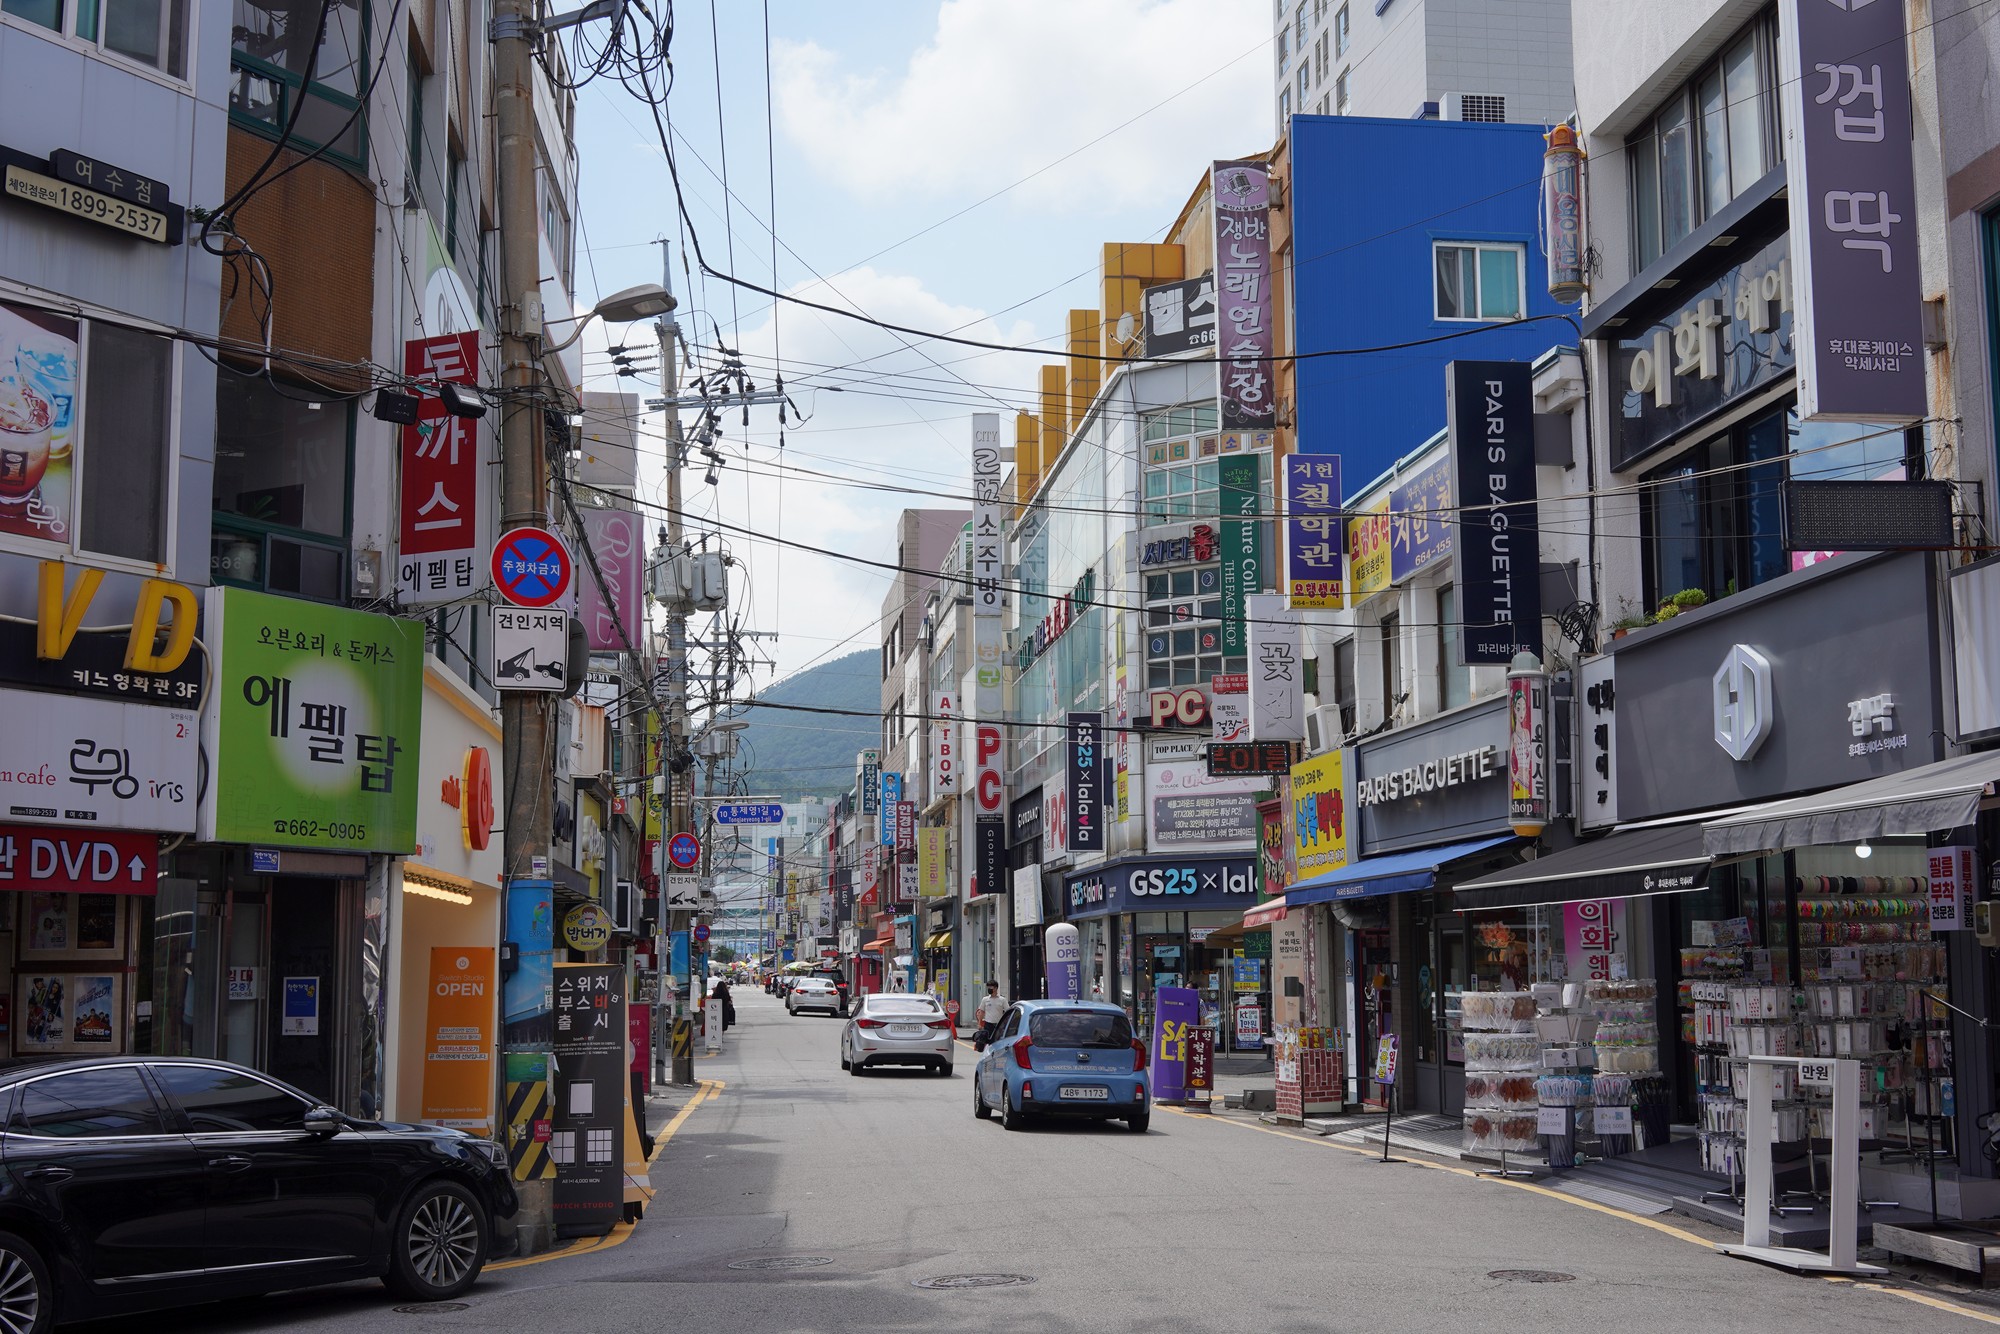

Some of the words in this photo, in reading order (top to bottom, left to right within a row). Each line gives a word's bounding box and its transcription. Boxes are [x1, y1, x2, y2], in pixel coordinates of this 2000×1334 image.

[60, 187, 163, 236] 1899-2537
[1220, 216, 1267, 241] 쟁반
[1225, 244, 1267, 402] 노래연습장
[1829, 339, 1913, 356] 휴대폰케이스
[1844, 356, 1901, 372] 악세사리
[1485, 380, 1506, 463] PARIS
[414, 342, 469, 532] 돈까스
[1293, 462, 1333, 478] 지헌
[1241, 496, 1255, 554] Nature
[1296, 483, 1338, 568] 철학관
[1391, 495, 1429, 554] 지헌
[1489, 474, 1512, 626] BAGUETTE
[402, 556, 474, 592] 에펠탑
[502, 559, 561, 578] 주정차금지
[497, 612, 564, 632] 견인지역
[257, 626, 325, 657] 오븐요리
[333, 644, 342, 656] &
[347, 635, 395, 664] 돈까스
[73, 670, 170, 695] 키노영화관
[175, 682, 198, 699] 3F
[1151, 690, 1207, 727] PC
[175, 723, 190, 738] 2F
[243, 674, 402, 794] 에펠탑
[1077, 722, 1093, 767] GS25
[1170, 744, 1193, 753] PLACE
[977, 727, 1002, 811] PC
[1358, 771, 1402, 807] PARIS
[1403, 745, 1495, 797] BAGUETTE
[148, 780, 184, 803] iris
[25, 808, 57, 817] 1899-2537
[731, 806, 769, 817] 통제영1길
[1018, 806, 1039, 829] GIORDANO
[1511, 801, 1533, 816] shop
[289, 819, 366, 840] 662-0905
[30, 838, 121, 883] DVD
[1930, 856, 1953, 878] 필름
[670, 876, 697, 884] 견인지역
[1129, 868, 1197, 897] GS25
[1931, 881, 1955, 903] 부착
[1932, 905, 1955, 920] 전문점
[566, 926, 606, 942] 밥버거
[1578, 901, 1617, 953] 이화
[436, 982, 484, 996] OPEN
[559, 975, 609, 993] 스위치
[558, 994, 608, 1012] 부스비
[1189, 1030, 1212, 1041] 지헌
[1377, 1037, 1391, 1079] 미용실
[1388, 1051, 1396, 1074] 입구
[1802, 1064, 1829, 1081] 만원
[1084, 1089, 1104, 1097] 1173
